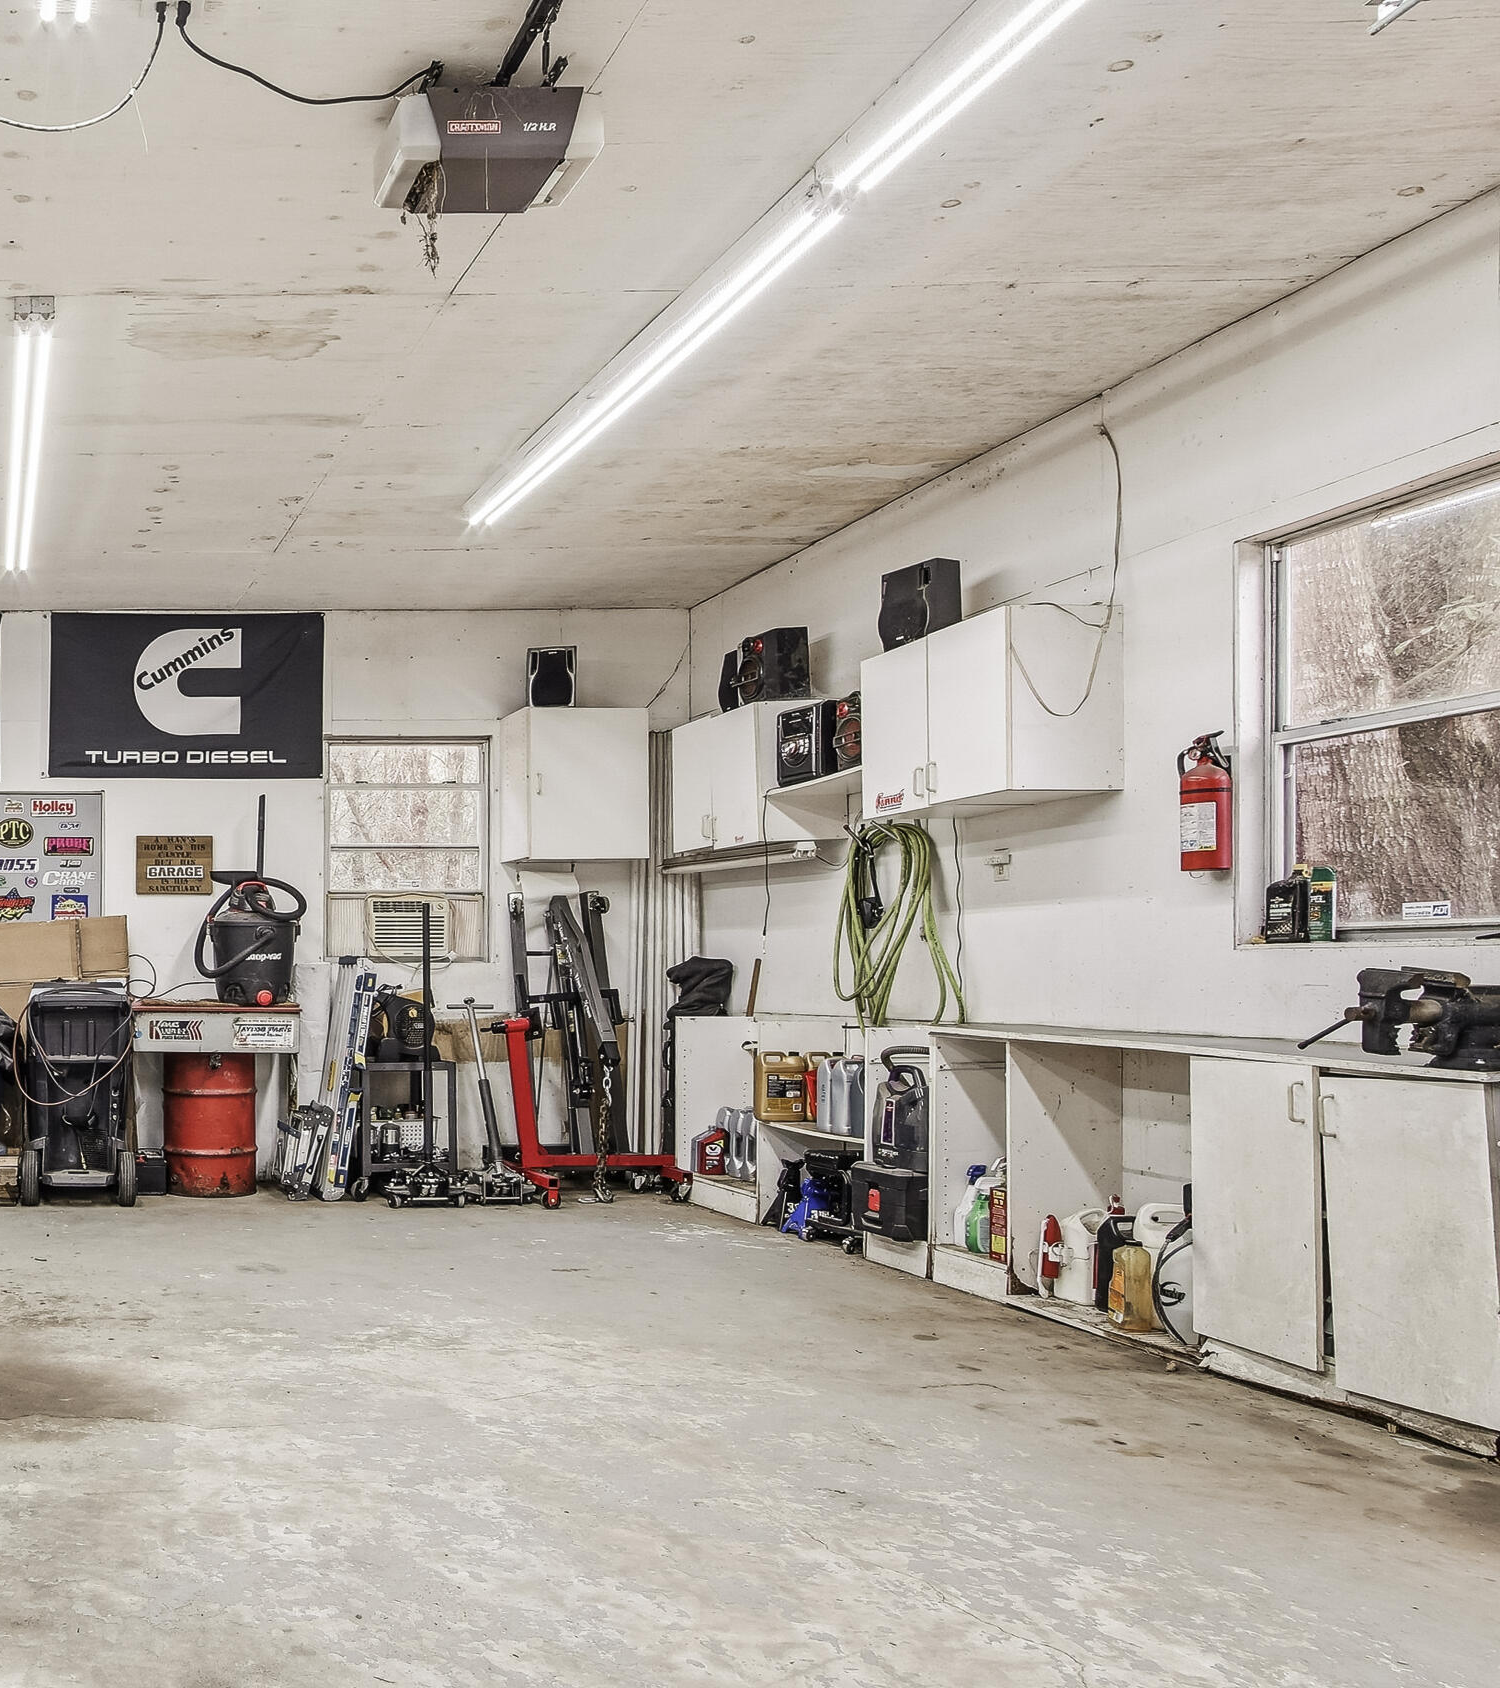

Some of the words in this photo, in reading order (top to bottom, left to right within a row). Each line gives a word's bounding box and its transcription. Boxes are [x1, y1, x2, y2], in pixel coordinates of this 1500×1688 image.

[136, 628, 235, 691] Cummins
[85, 751, 179, 763] TURBO
[186, 751, 287, 763] DIESEL
[32, 801, 74, 815] Holley
[0, 820, 30, 840] PTC
[148, 867, 202, 876] GARAGE
